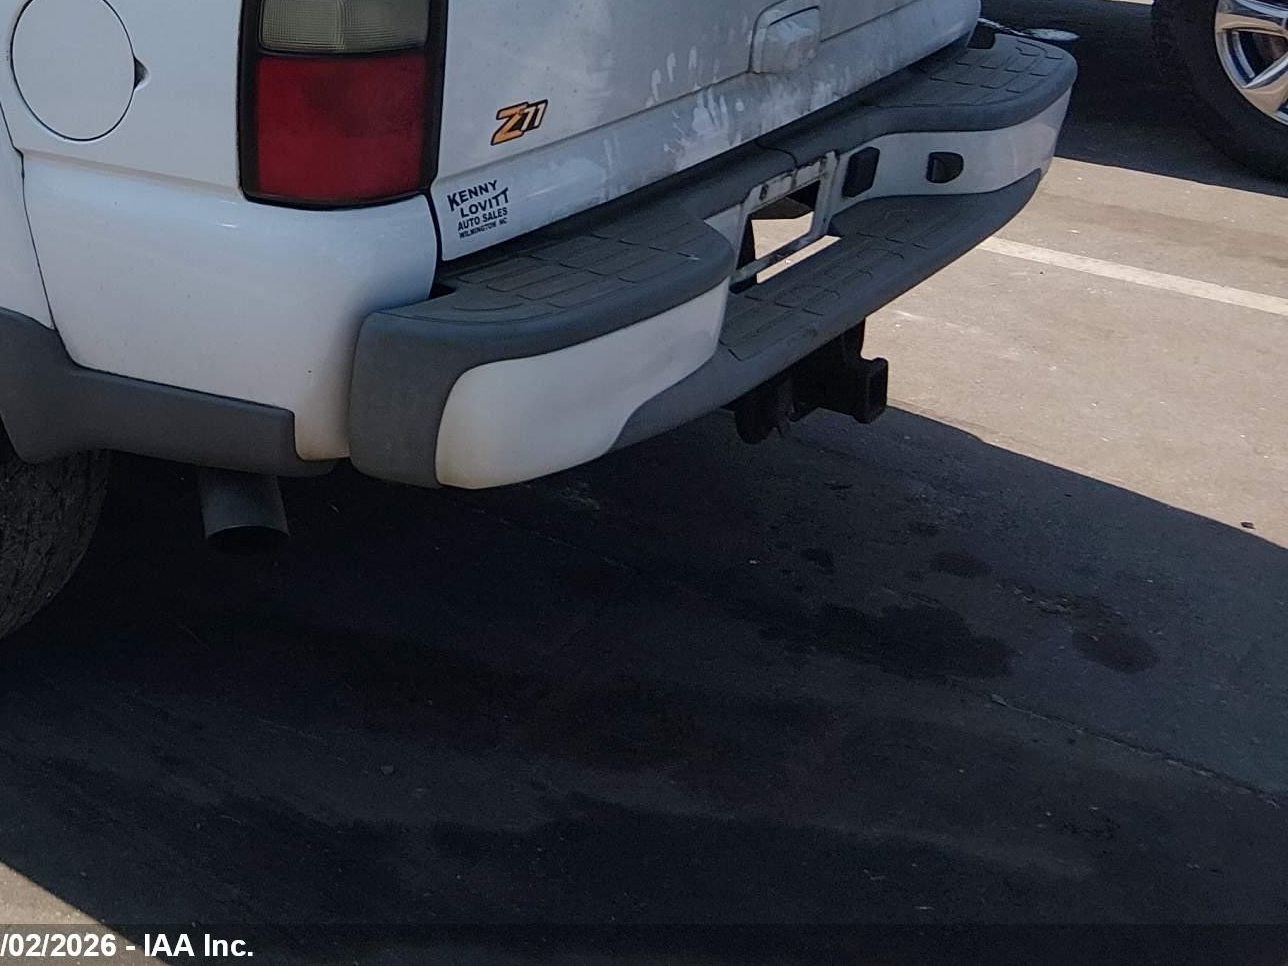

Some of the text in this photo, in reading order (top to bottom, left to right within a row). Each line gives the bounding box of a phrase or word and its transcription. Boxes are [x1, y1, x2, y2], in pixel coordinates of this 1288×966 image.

[491, 99, 548, 146] Z71
[447, 179, 497, 212] KENNY
[460, 187, 509, 218] LOVITT
[457, 207, 508, 232] AUTO SALES
